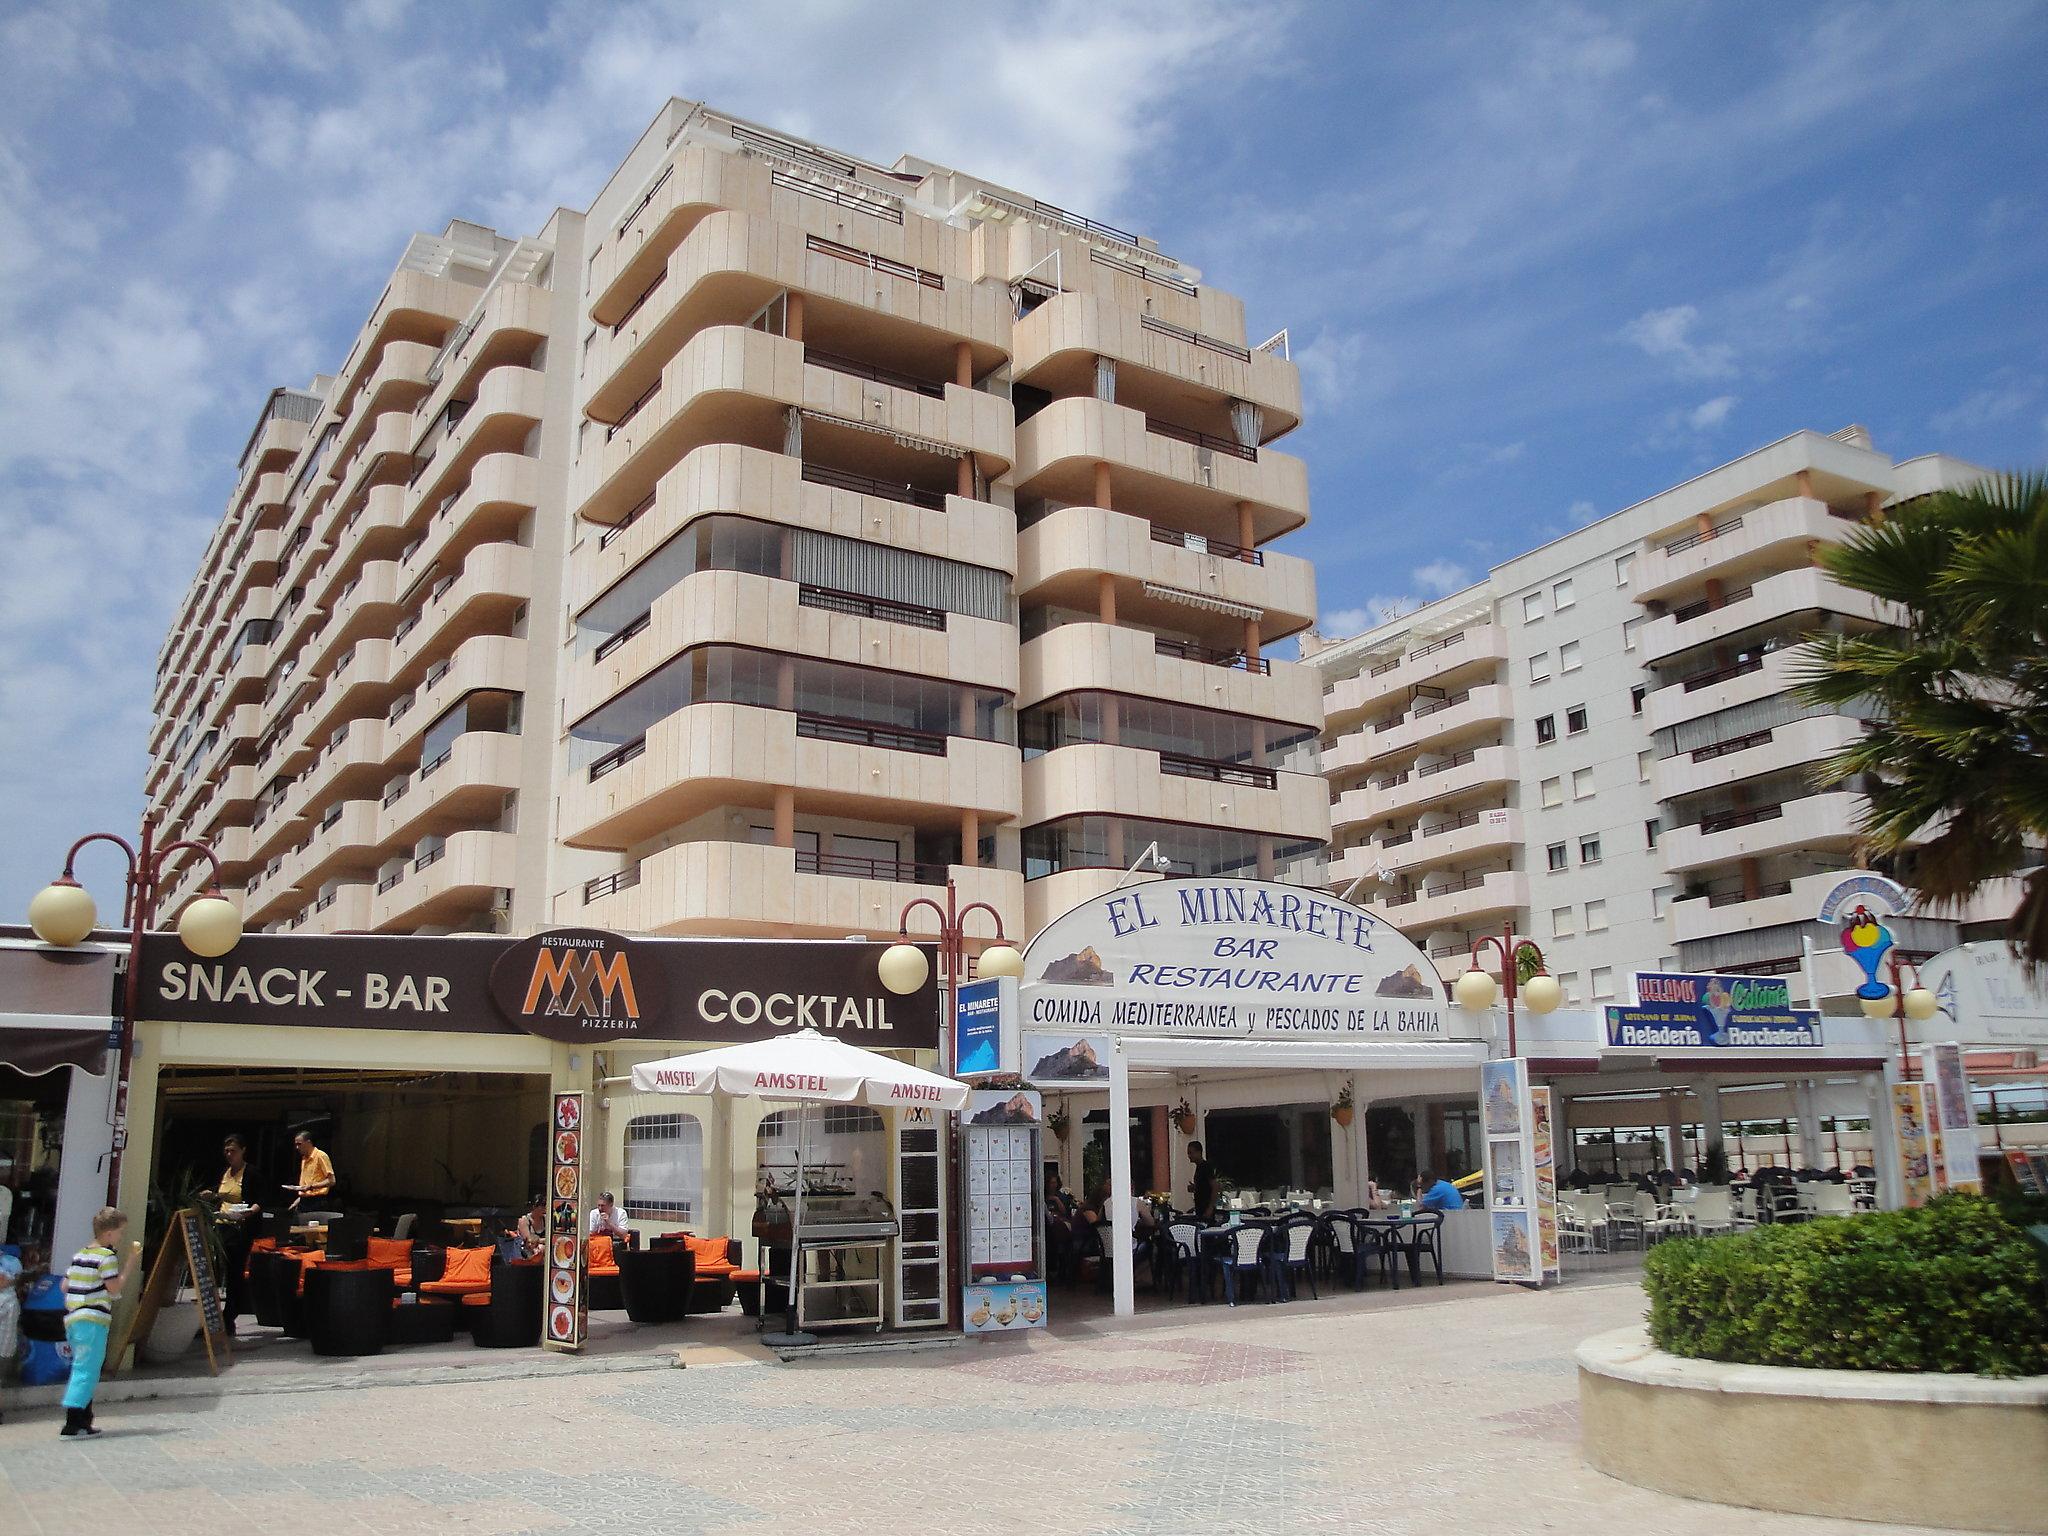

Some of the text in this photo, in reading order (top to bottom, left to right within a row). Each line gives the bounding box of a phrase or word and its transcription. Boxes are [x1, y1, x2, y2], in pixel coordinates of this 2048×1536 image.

[1105, 886, 1376, 955] EL MINARETE
[542, 937, 605, 949] RESTAURANTE
[1213, 937, 1279, 960] BAR
[159, 962, 327, 1007] SNACK
[365, 973, 451, 1012] BAR
[1128, 964, 1364, 993] RESTAURANTE
[1638, 978, 1696, 1003] HELADOS
[698, 989, 893, 1029] COCKTAIL
[959, 997, 998, 1013] EL MINARETE
[1033, 998, 1101, 1025] COMIDA
[1111, 1001, 1237, 1028] MEDITERRANEA
[1266, 1007, 1339, 1031] PESCADOS
[1347, 1009, 1365, 1031] DE
[1373, 1010, 1389, 1032] LA
[1398, 1011, 1439, 1032] BAHIA
[582, 1019, 638, 1029] PIZZERIA
[656, 1070, 697, 1087] AMSTEL
[754, 1072, 828, 1092] AMSTEL
[890, 1083, 943, 1102] AMSTEL
